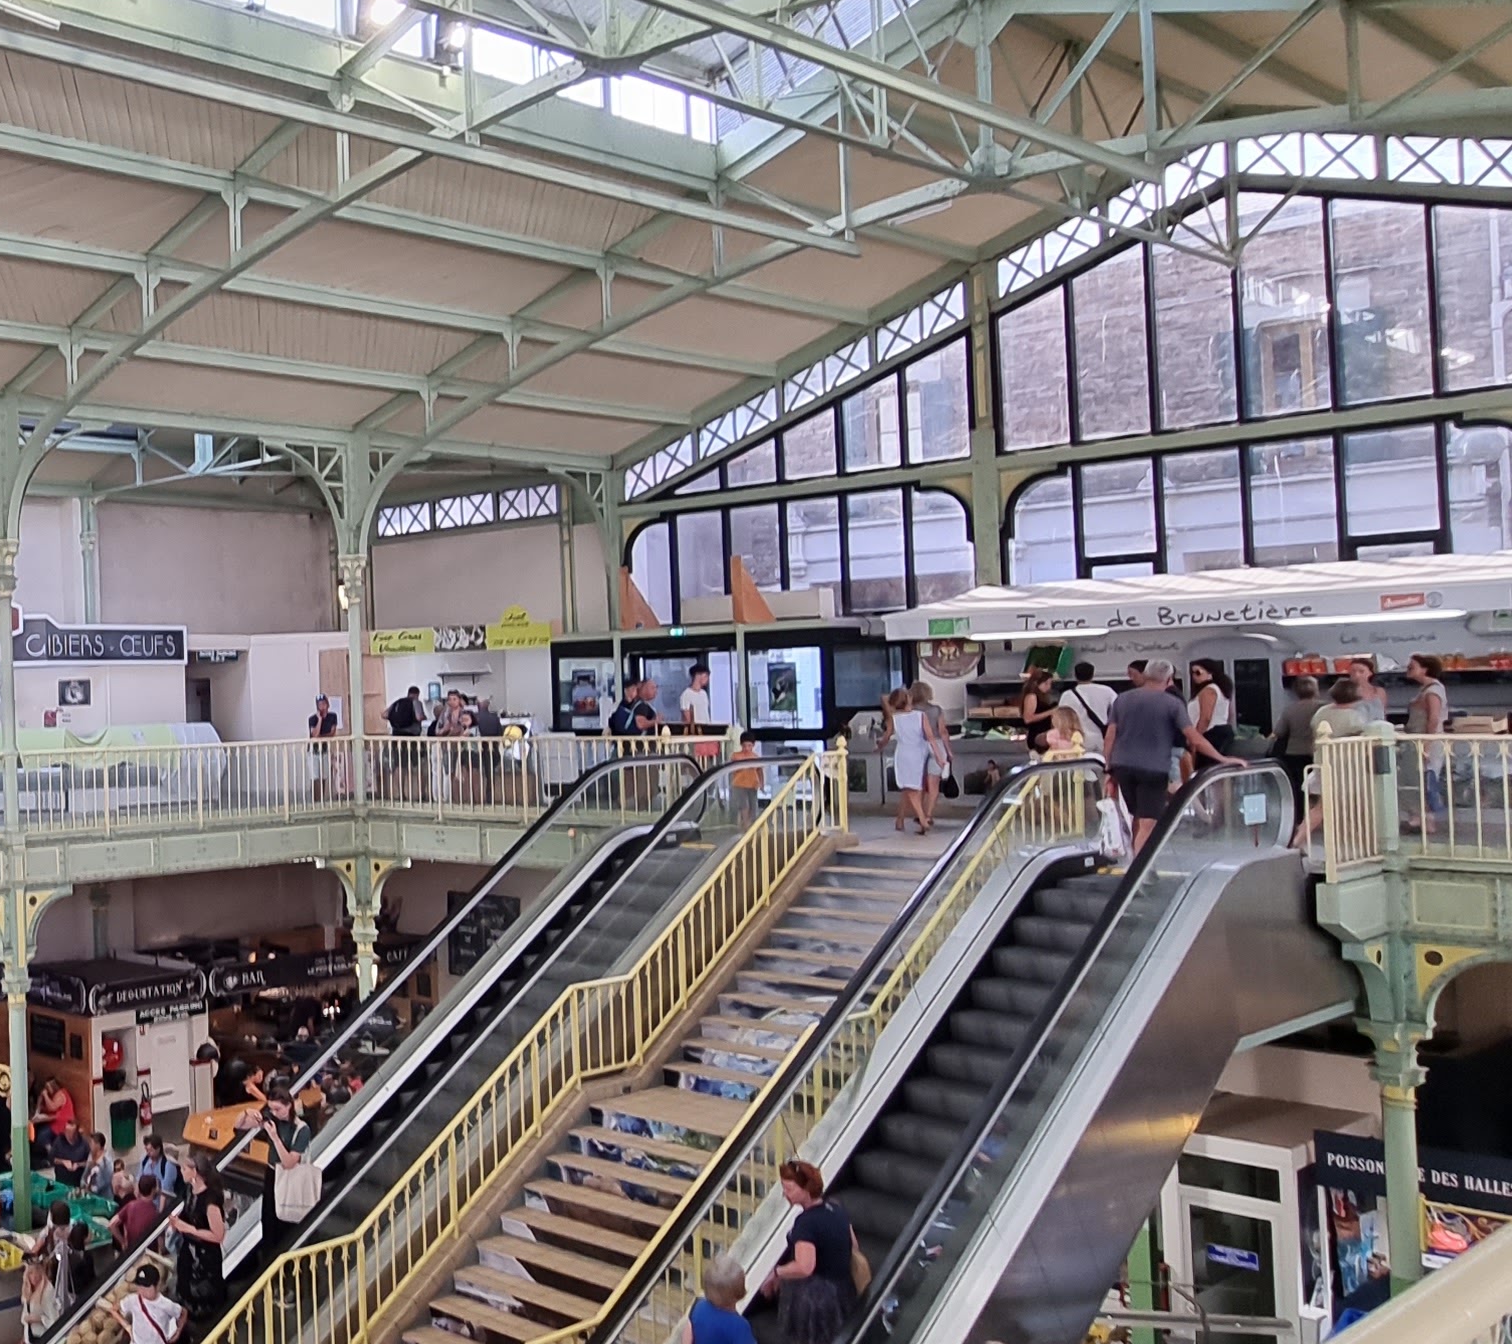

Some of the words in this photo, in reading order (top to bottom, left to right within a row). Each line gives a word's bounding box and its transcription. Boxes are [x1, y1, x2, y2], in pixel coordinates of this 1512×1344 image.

[1016, 613, 1090, 631] Terre
[1107, 608, 1140, 628] de
[25, 631, 105, 657] GIBIERS
[119, 629, 176, 657] ŒUFS
[1326, 1151, 1426, 1183] POISSONE
[1431, 1169, 1459, 1189] DES
[1464, 1175, 1512, 1197] HALLE
